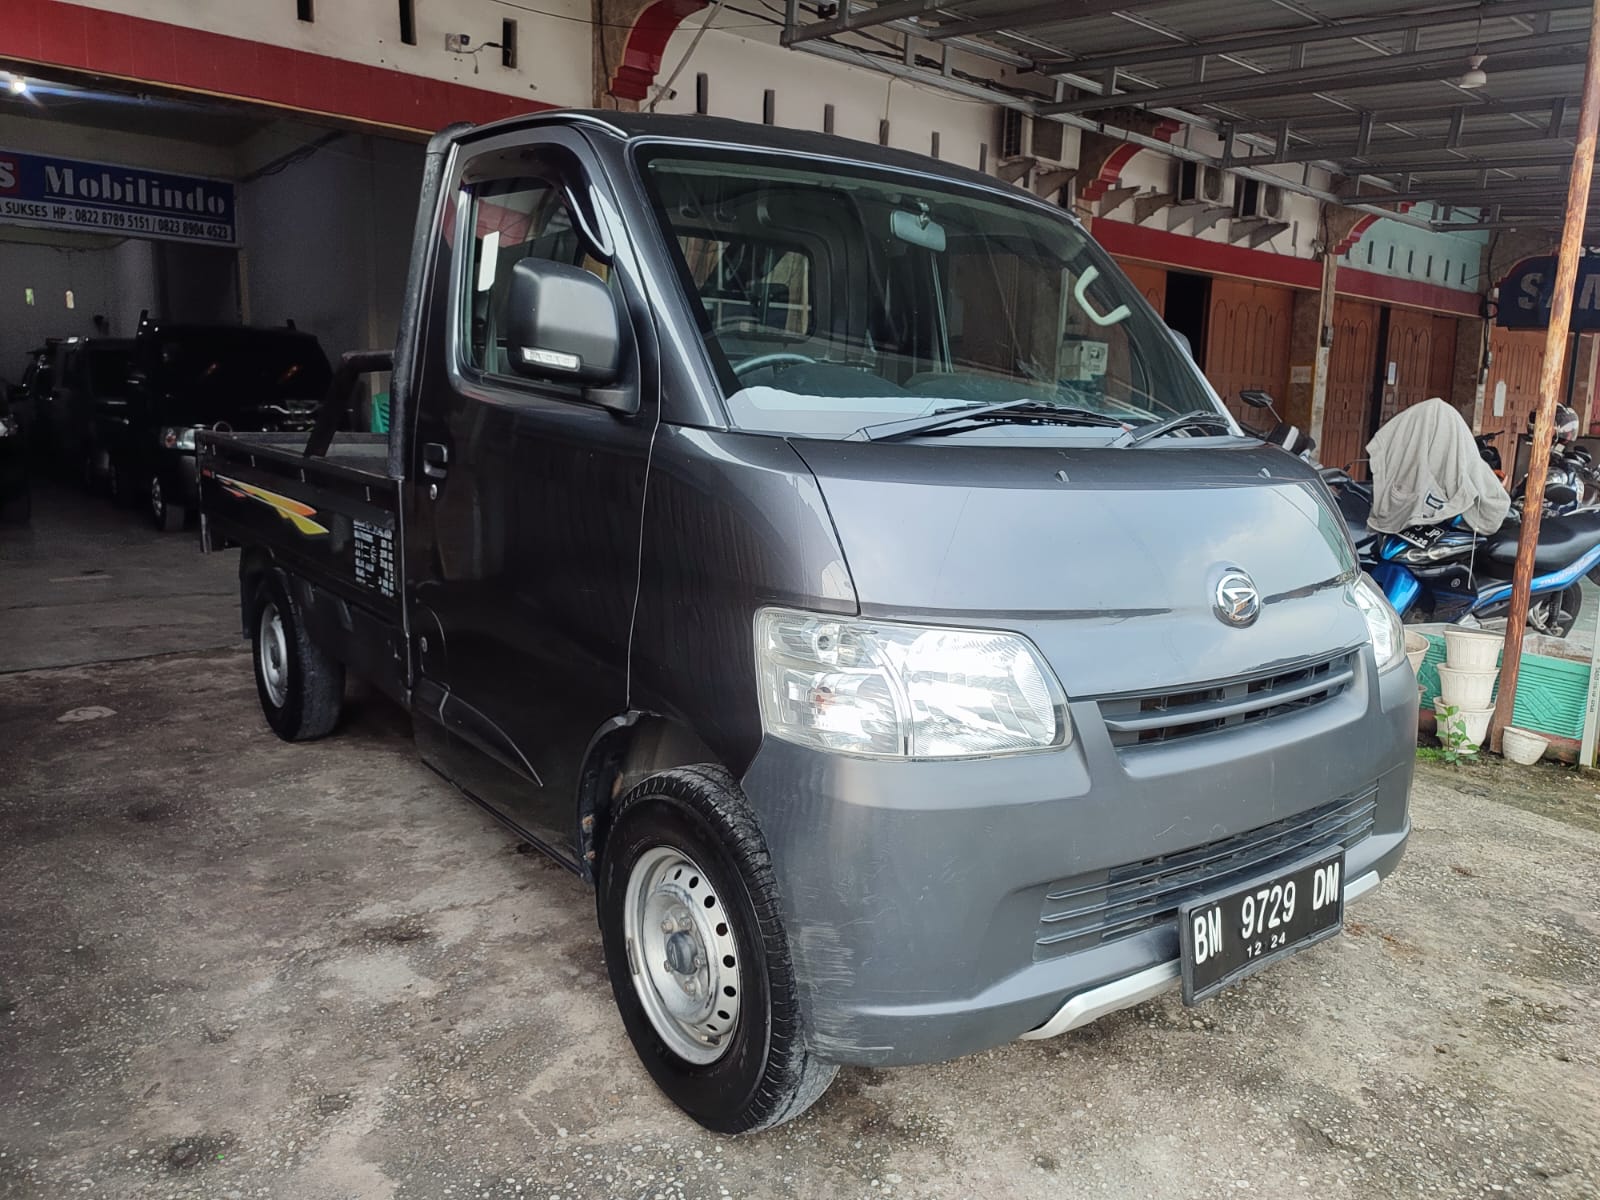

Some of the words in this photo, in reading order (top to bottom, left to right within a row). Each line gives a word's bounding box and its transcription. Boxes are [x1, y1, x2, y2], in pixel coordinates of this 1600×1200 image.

[44, 165, 225, 214] Mobilindo
[5, 201, 48, 217] SUKSES
[52, 205, 66, 219] HP
[75, 210, 99, 224] 0822
[102, 213, 125, 227] 8789
[127, 215, 150, 230] 5151
[1193, 906, 1223, 965] BM
[1241, 881, 1296, 939] 9729
[1312, 862, 1339, 910] DM
